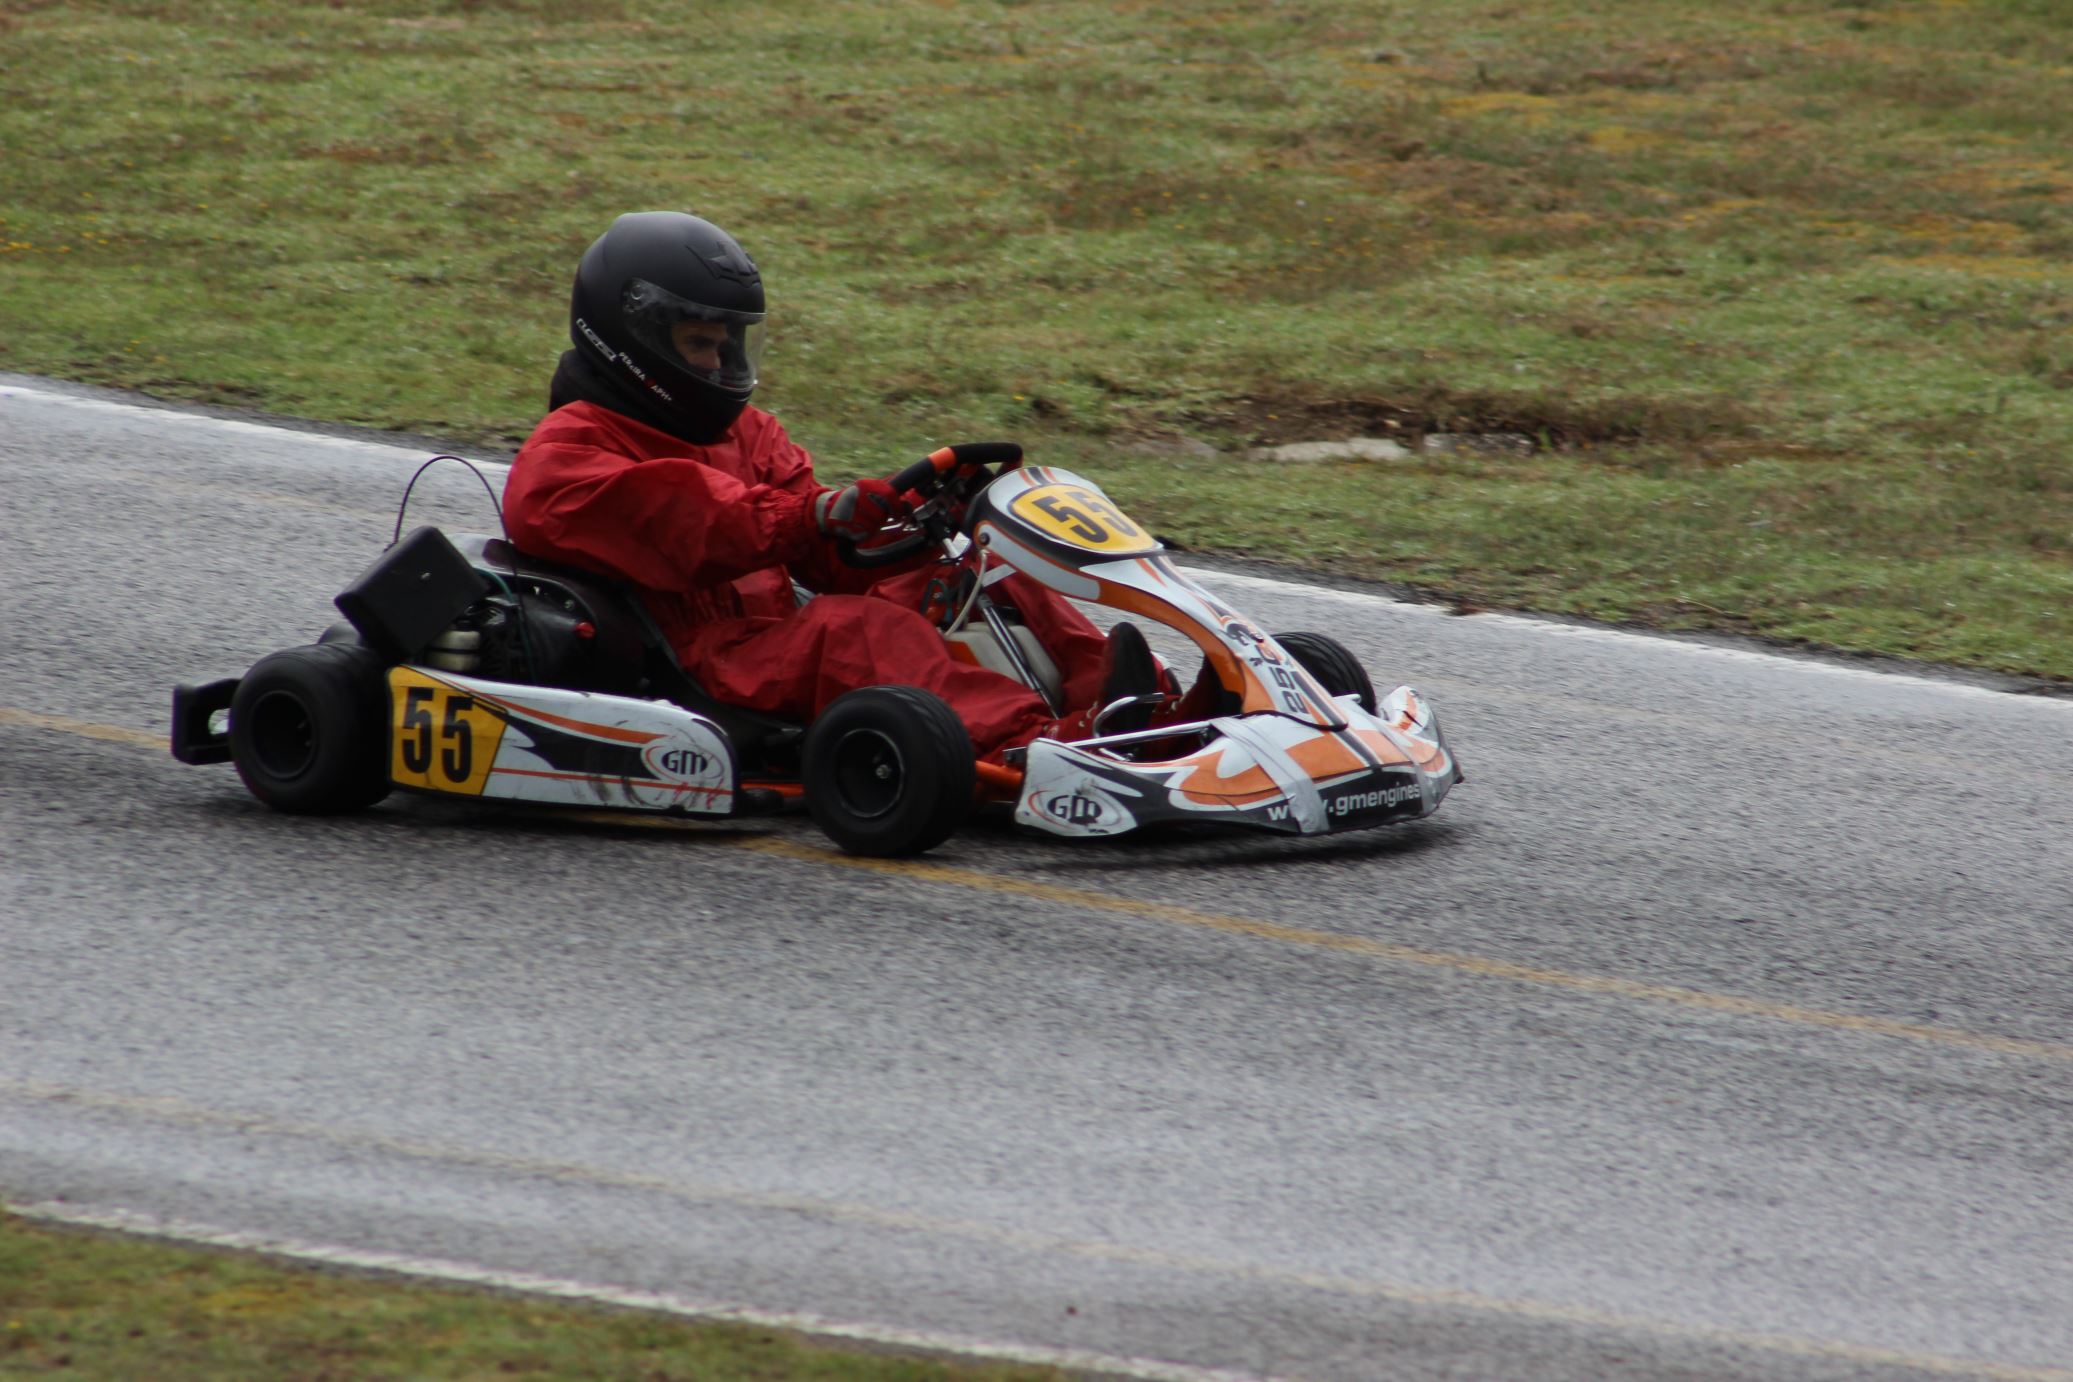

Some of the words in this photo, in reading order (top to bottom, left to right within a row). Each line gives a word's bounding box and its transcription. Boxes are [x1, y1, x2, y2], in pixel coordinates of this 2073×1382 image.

[1032, 491, 1138, 543] 55
[402, 686, 474, 783] 55
[1267, 781, 1421, 821] w.gmengines
